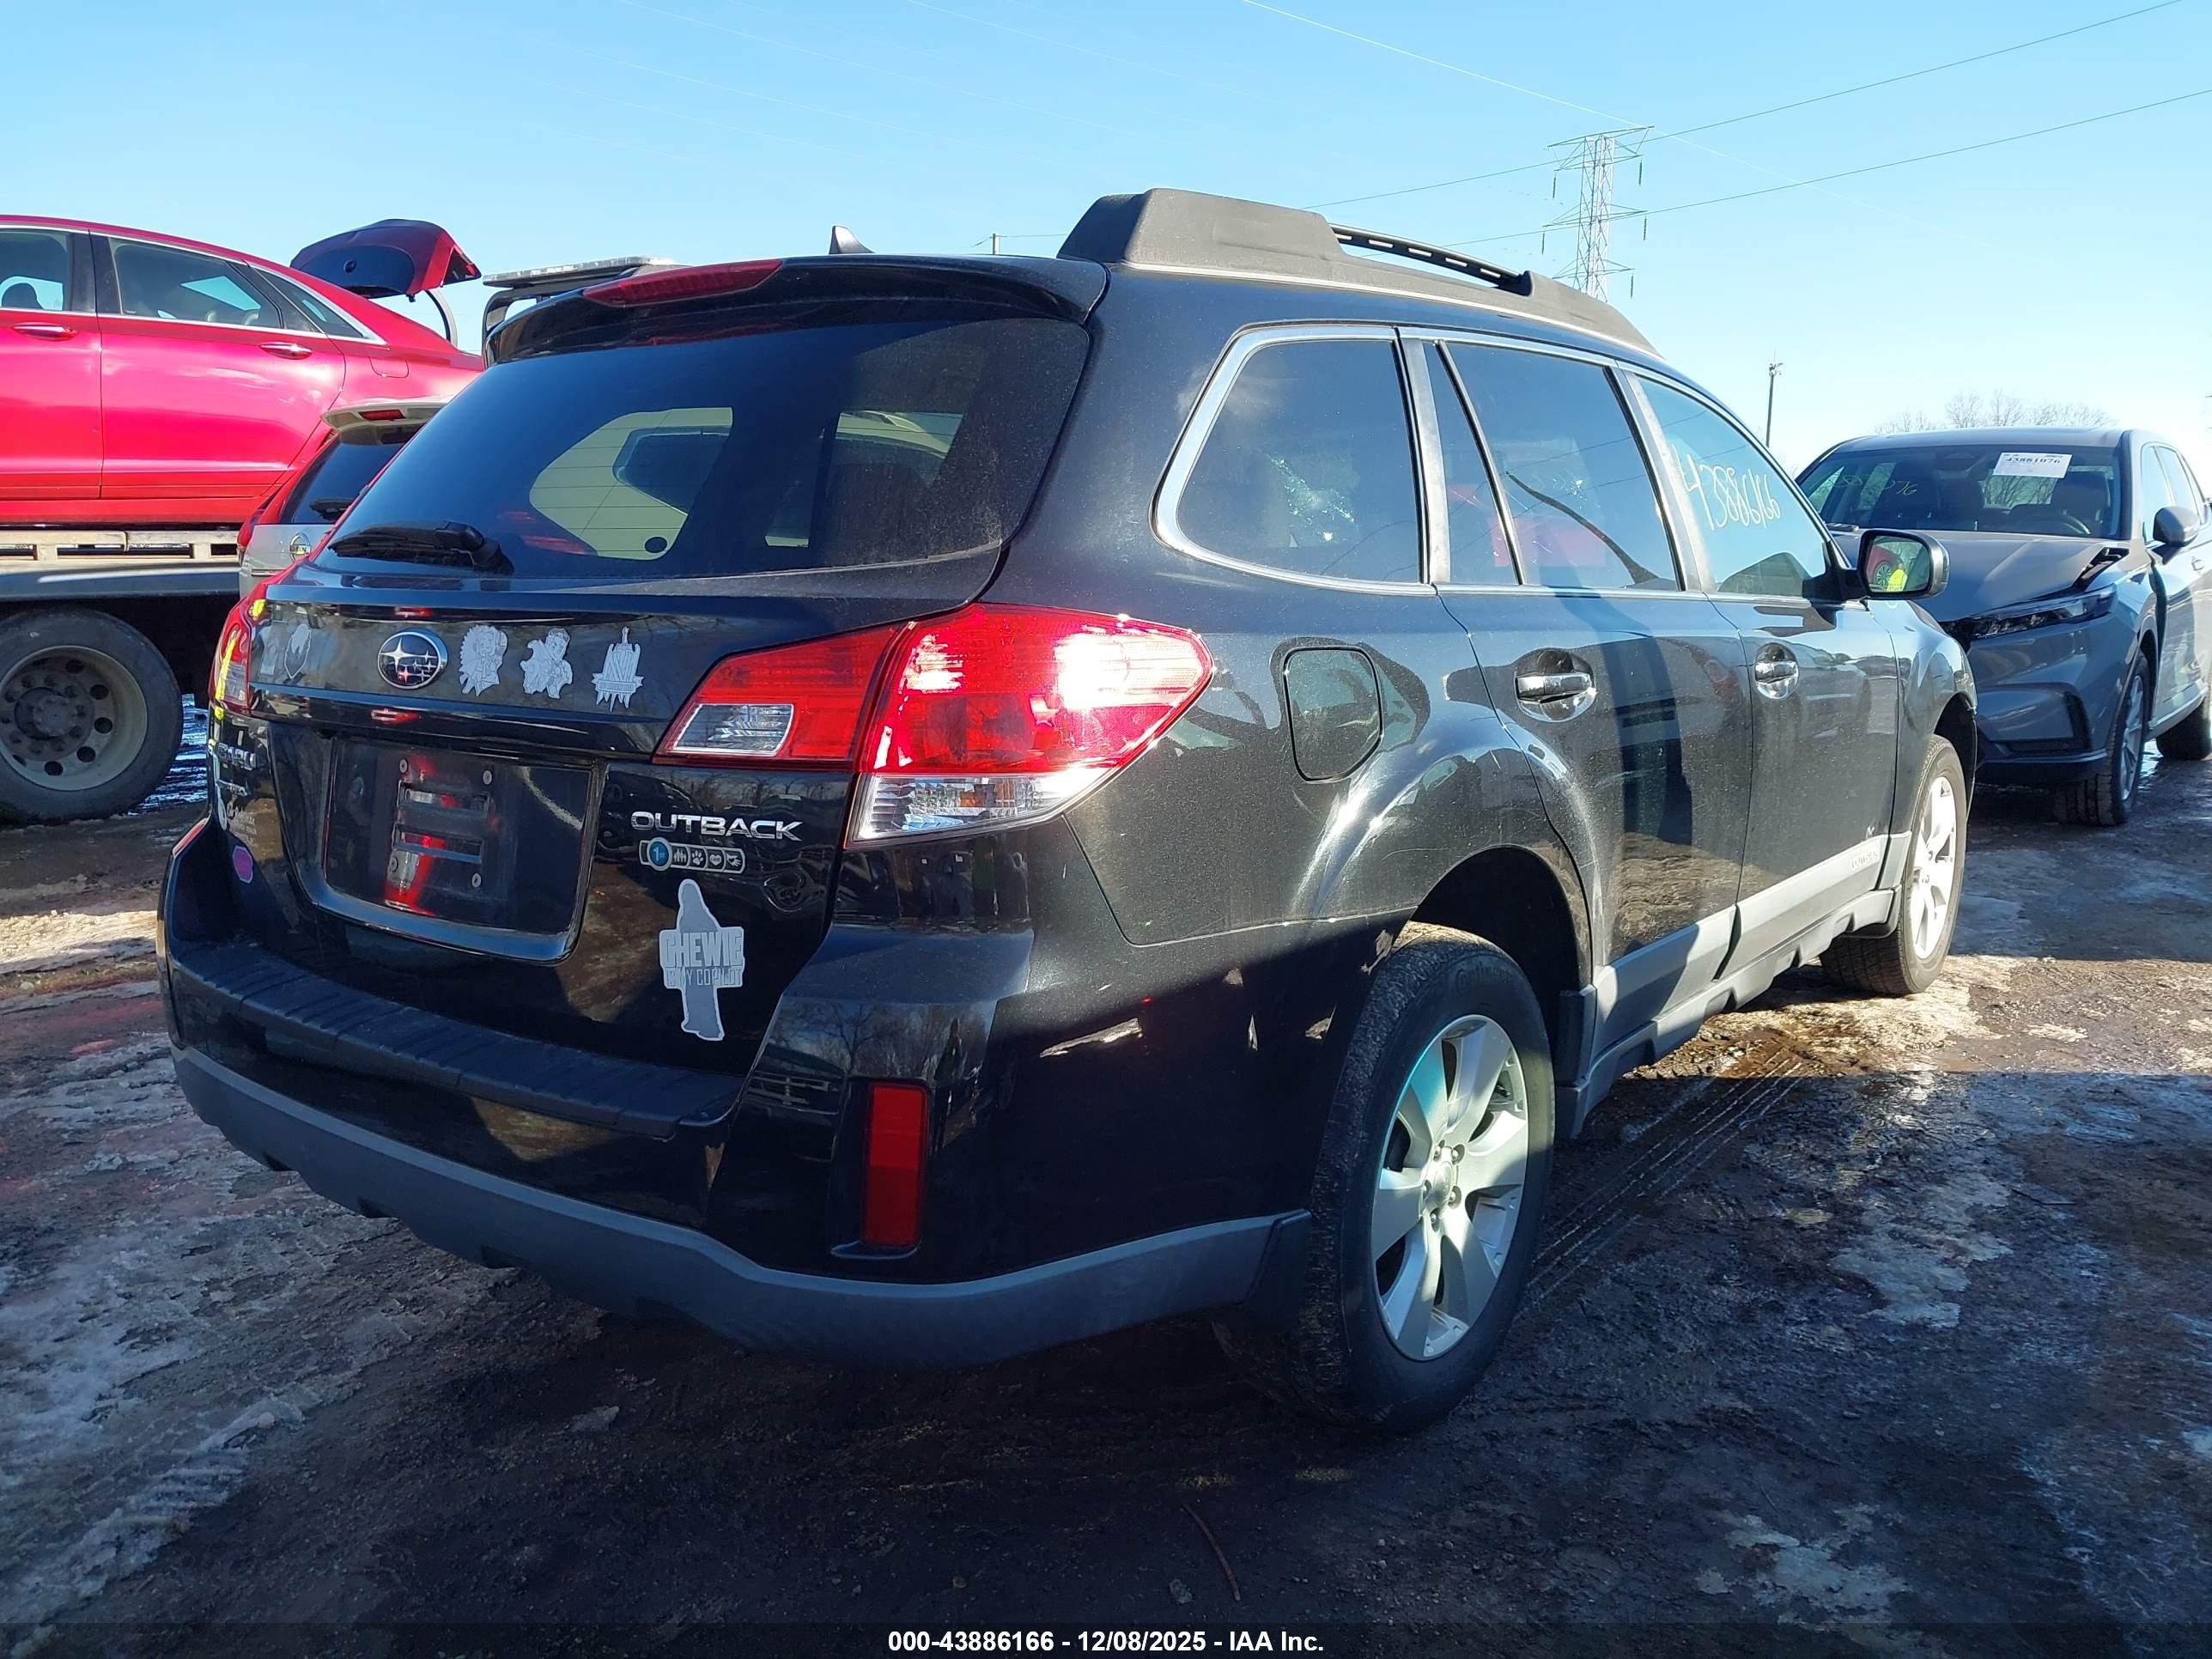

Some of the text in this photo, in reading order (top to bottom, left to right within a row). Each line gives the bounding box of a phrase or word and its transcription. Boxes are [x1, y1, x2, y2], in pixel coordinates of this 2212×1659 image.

[630, 811, 804, 842] OUTBACK
[662, 932, 743, 968] CHEWIE
[696, 968, 742, 987] COPILOT
